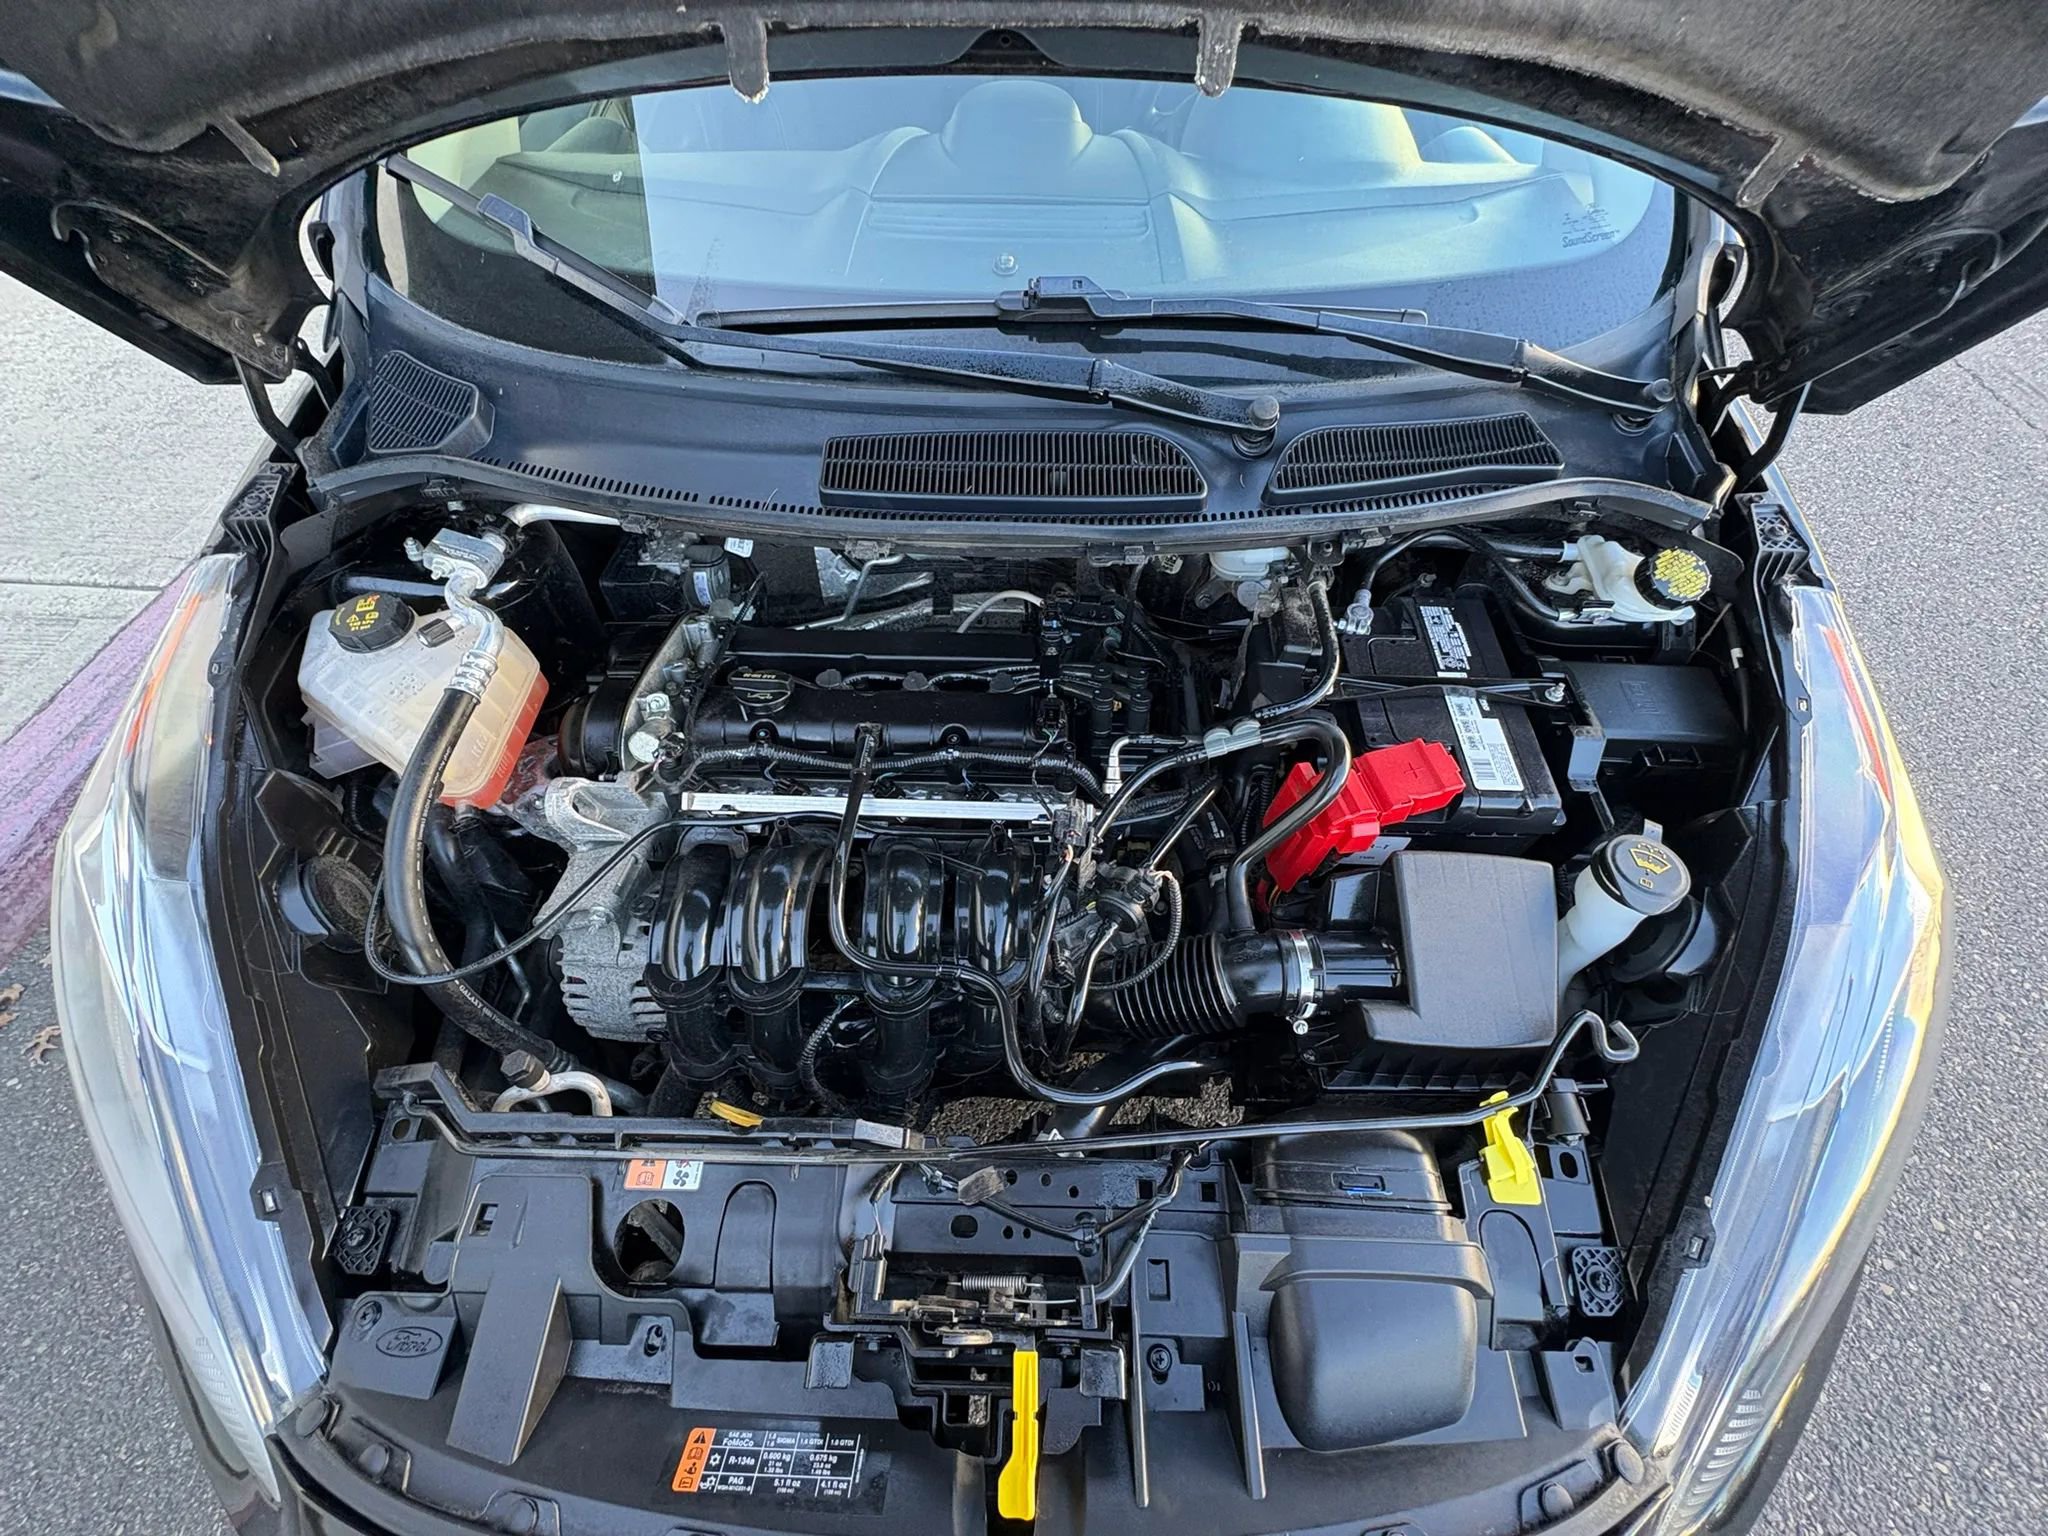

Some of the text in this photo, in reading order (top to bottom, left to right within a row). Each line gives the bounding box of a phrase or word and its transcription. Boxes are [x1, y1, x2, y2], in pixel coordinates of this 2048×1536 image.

[459, 984, 484, 1009] GALAXY
[722, 1437, 754, 1447] FoMoCo
[776, 1436, 796, 1444] SIGMA
[728, 1455, 755, 1466] R-134a
[781, 1452, 791, 1462] kg
[828, 1454, 838, 1464] kg
[727, 1475, 744, 1485] PAG
[791, 1480, 801, 1488] oz
[820, 1480, 831, 1488] 4.1
